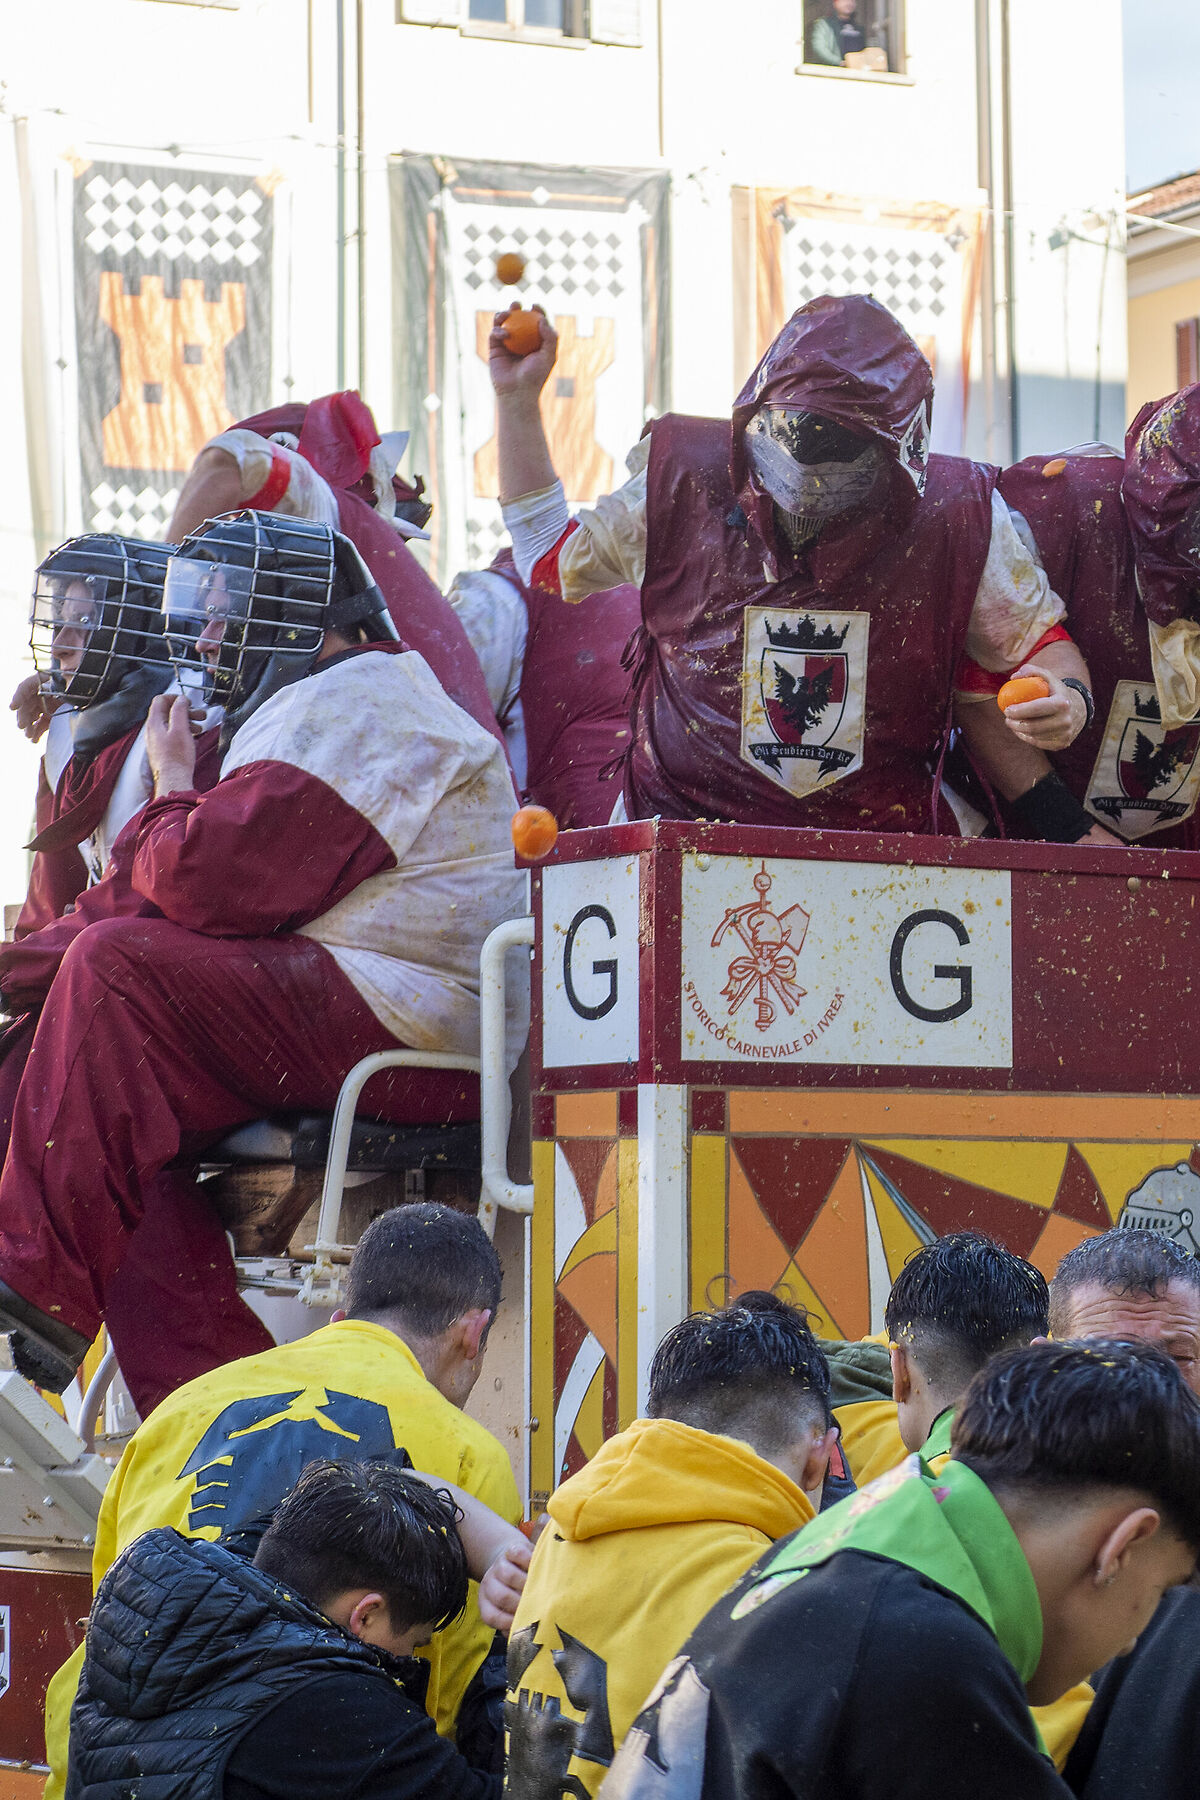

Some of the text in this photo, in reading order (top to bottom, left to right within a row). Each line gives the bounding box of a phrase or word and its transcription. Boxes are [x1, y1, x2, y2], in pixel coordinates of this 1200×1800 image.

[754, 745, 850, 763] Gli Scudieri Del Re
[563, 903, 618, 1021] G
[889, 908, 973, 1023] G
[684, 981, 846, 1059] STORICO CARNEVALE DI IVREA
